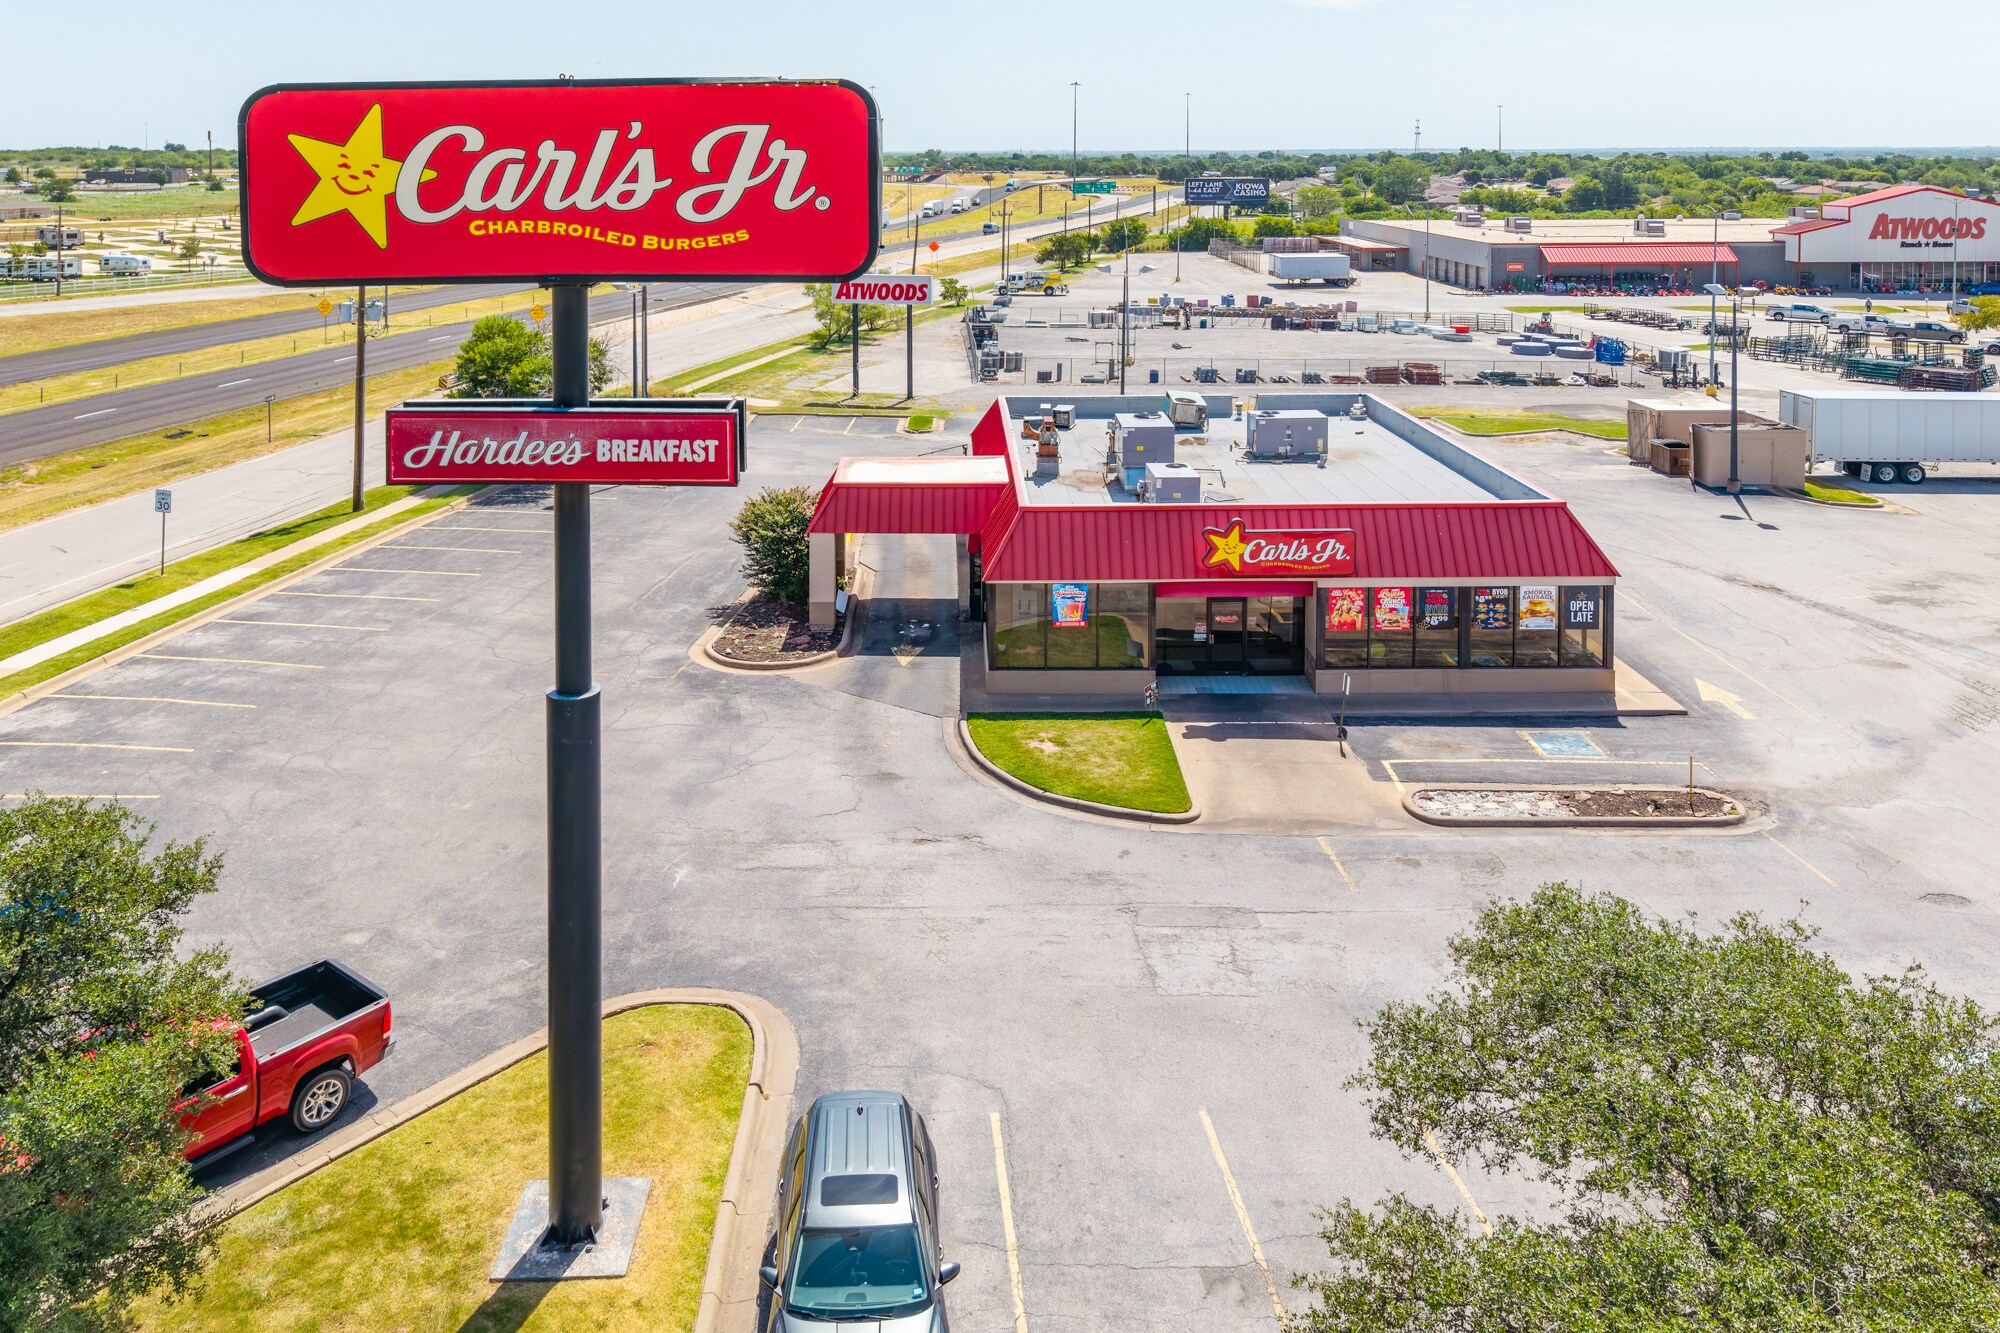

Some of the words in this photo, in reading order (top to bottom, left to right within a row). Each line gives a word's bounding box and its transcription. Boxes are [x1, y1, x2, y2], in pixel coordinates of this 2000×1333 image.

[395, 120, 674, 224] Carl's
[1233, 189, 1267, 197] CASINO
[1235, 182, 1265, 190] KIOWA
[1868, 212, 1987, 240] ATWOODS
[469, 219, 637, 247] CHARBROILED
[642, 229, 750, 250] BURGERS
[1900, 240, 1922, 248] Ranch
[1931, 240, 1954, 248] Home
[835, 281, 929, 301] ATWOODS
[402, 430, 592, 469] Hardee's
[597, 439, 719, 463] BREAKFAST
[156, 501, 170, 510] 30
[1243, 538, 1311, 564] Carl's
[1311, 538, 1351, 564] Jr.
[1570, 600, 1594, 611] OPEN
[1570, 611, 1593, 622] LATE
